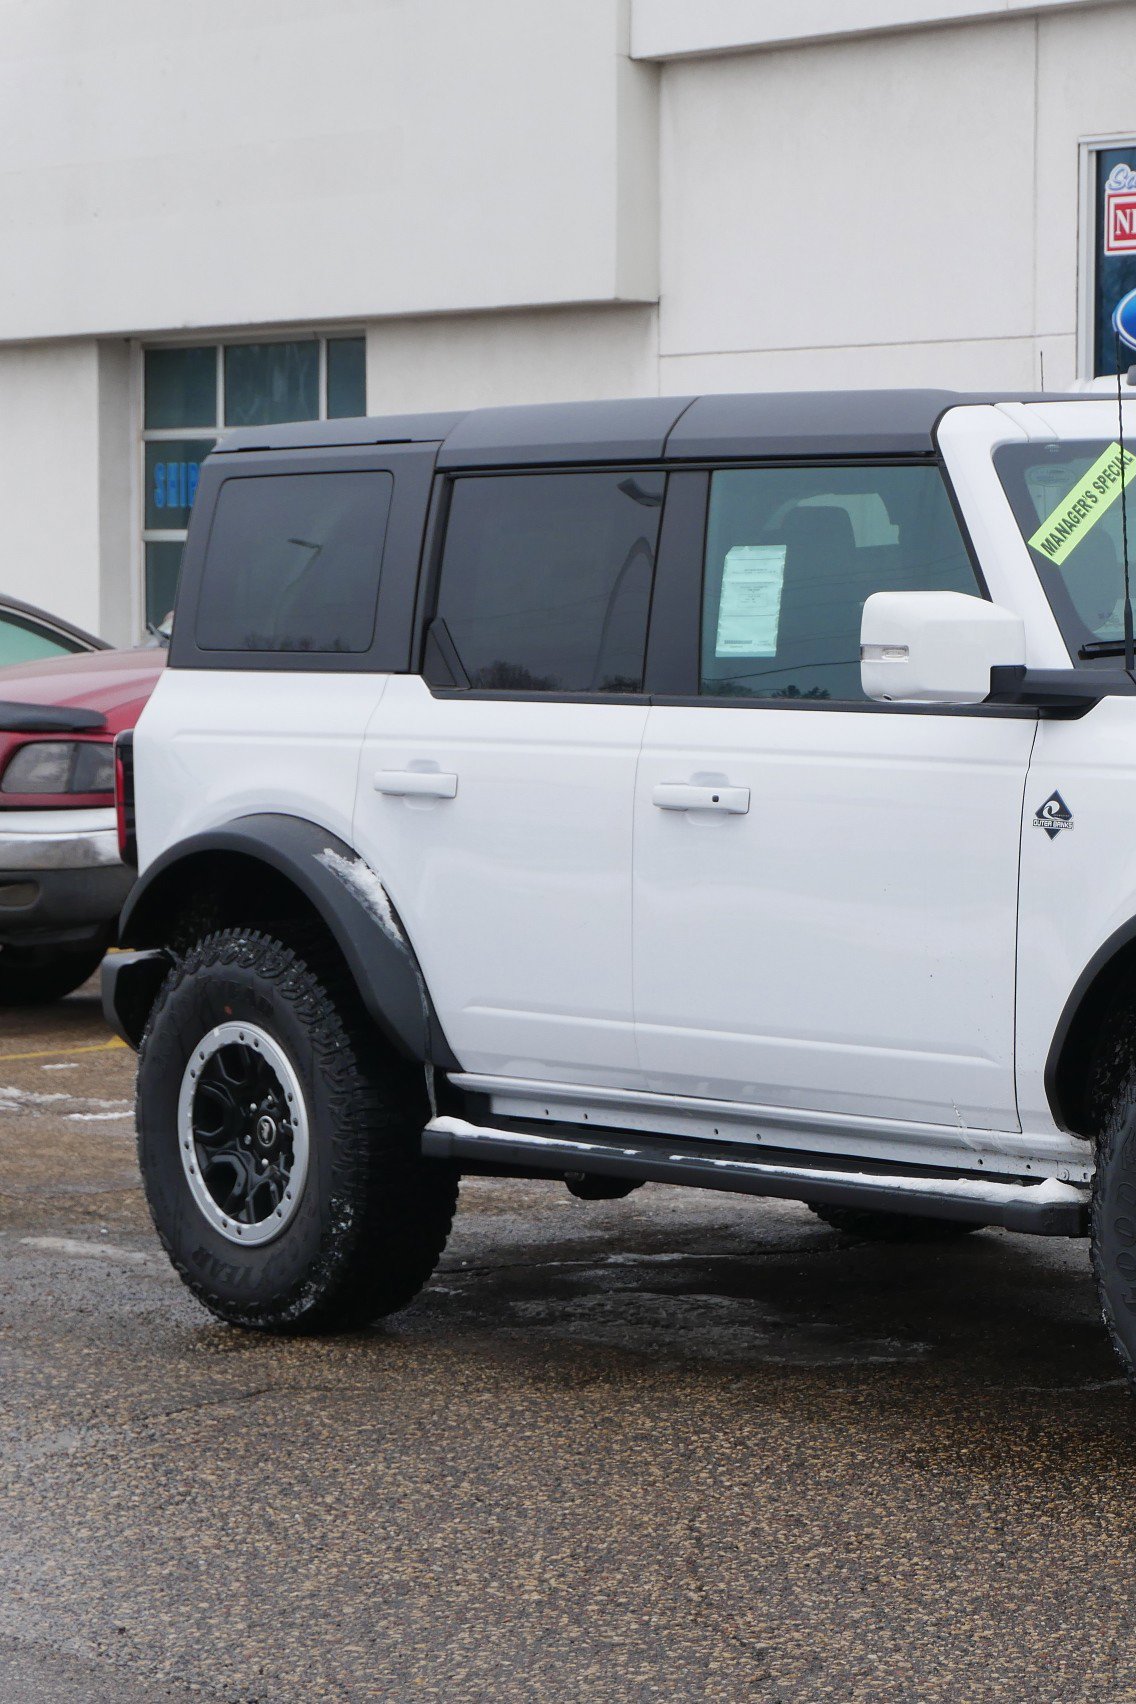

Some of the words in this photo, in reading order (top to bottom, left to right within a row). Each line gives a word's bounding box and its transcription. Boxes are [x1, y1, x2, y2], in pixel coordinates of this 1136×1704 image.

[1040, 489, 1098, 556] MANAGER'S
[1092, 451, 1134, 495] SPECIAL
[1033, 819, 1053, 827] OUTER
